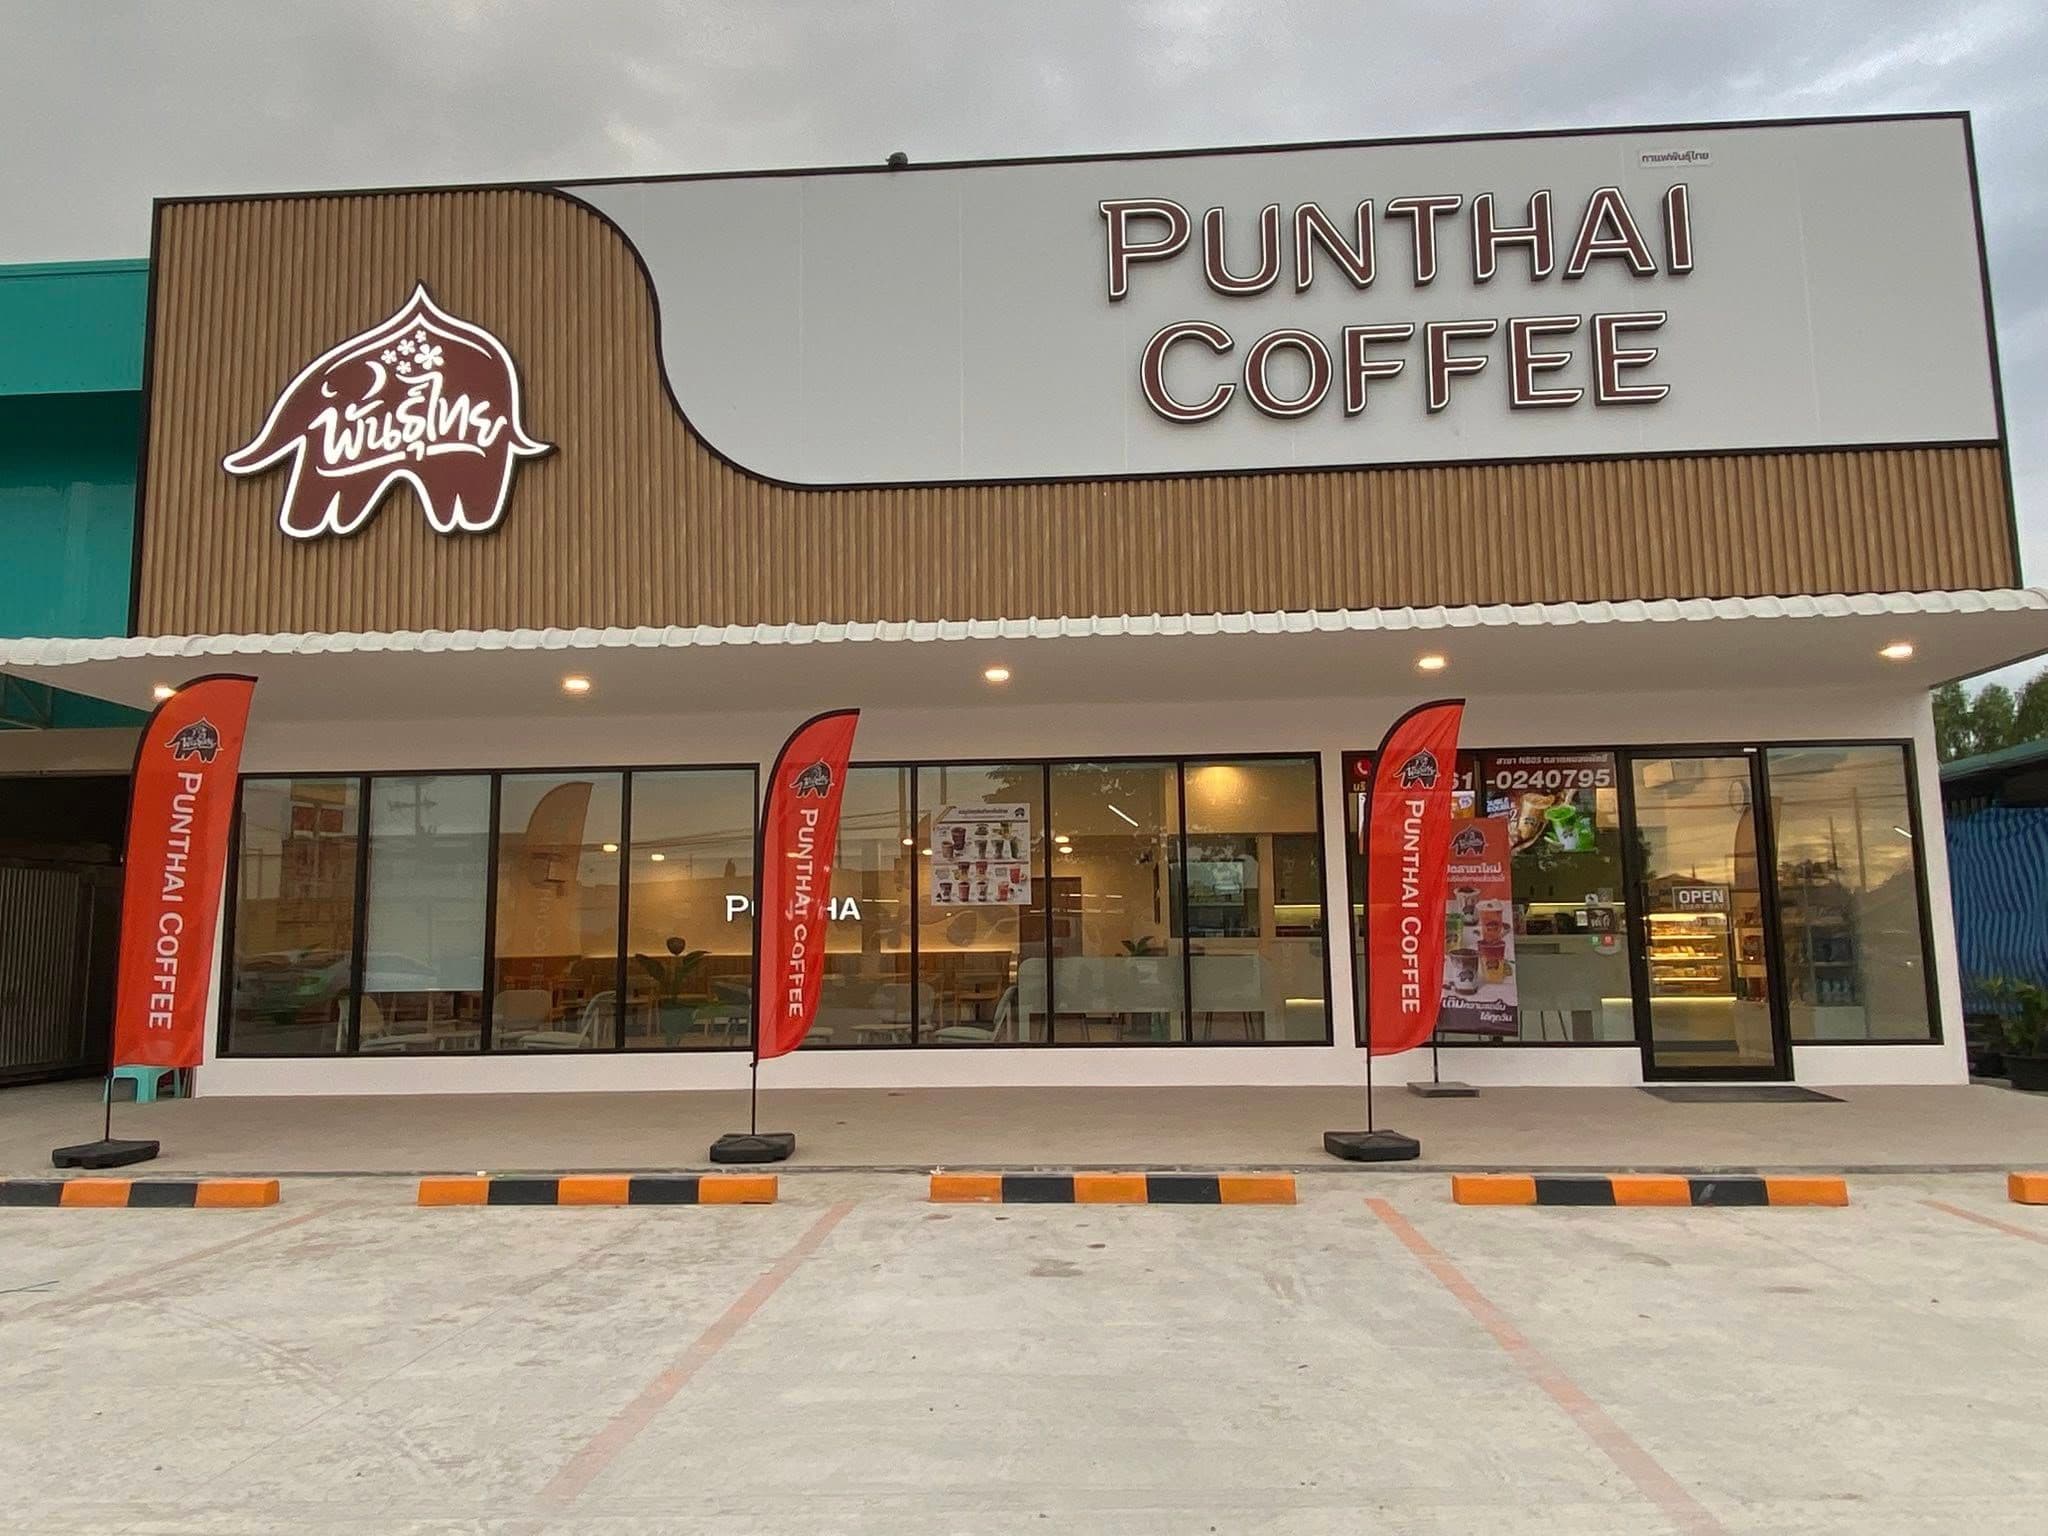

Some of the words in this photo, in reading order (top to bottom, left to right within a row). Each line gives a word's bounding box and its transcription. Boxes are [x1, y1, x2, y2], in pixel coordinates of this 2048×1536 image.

[1100, 182, 1694, 304] PUNTHAI
[308, 371, 507, 464] พันธุ์ไทย
[1140, 311, 1671, 423] COFFEE
[162, 771, 202, 904] PUNTHAI
[794, 808, 818, 916] PUNTHAI
[1401, 800, 1425, 908] PUNTHAI
[1679, 890, 1725, 904] OPEN
[148, 912, 184, 1030] COFFEE
[789, 923, 807, 1018] COFFEE
[1401, 917, 1421, 1014] COFFEE
